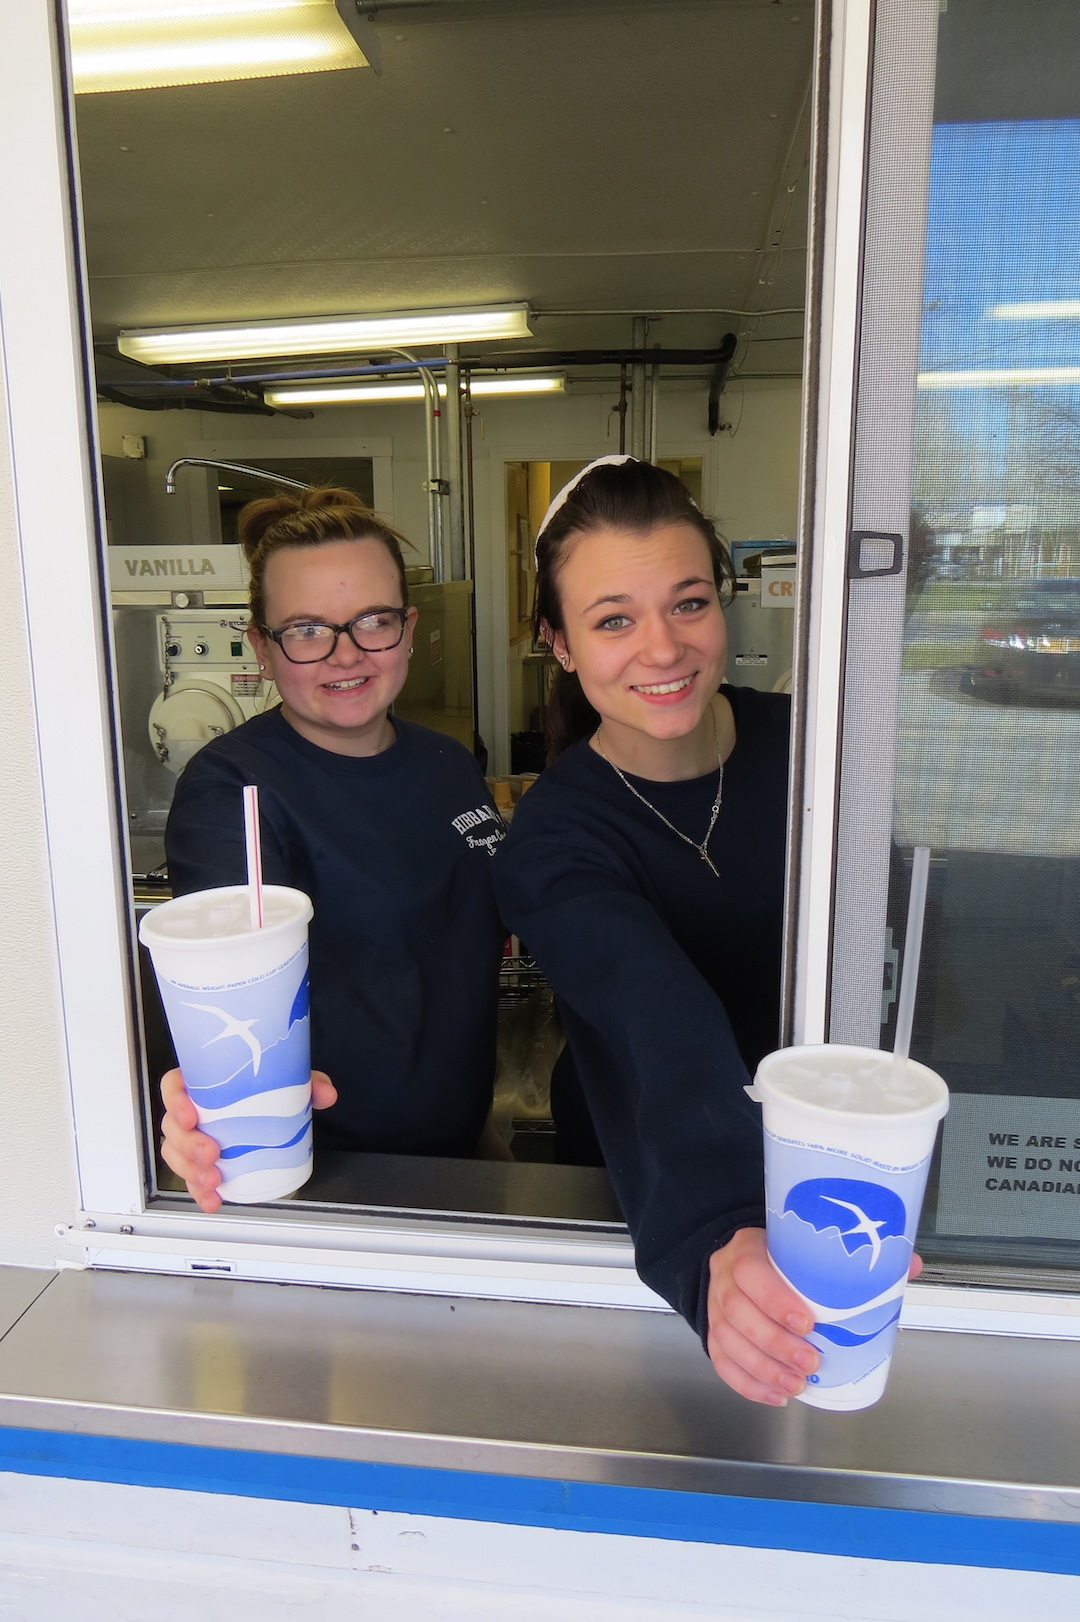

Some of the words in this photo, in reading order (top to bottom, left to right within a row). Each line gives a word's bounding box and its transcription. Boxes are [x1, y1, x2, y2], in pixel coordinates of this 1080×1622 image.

[125, 559, 215, 576] VANILLA
[768, 580, 796, 597] CR
[227, 980, 246, 988] PAPER
[247, 974, 265, 984] COLD
[988, 1132, 1019, 1146] WE
[1025, 1135, 1066, 1148] ARE
[827, 1147, 848, 1156] MORE
[850, 1152, 872, 1163] SOLID
[987, 1155, 1017, 1169] WE
[1024, 1157, 1053, 1171] DO
